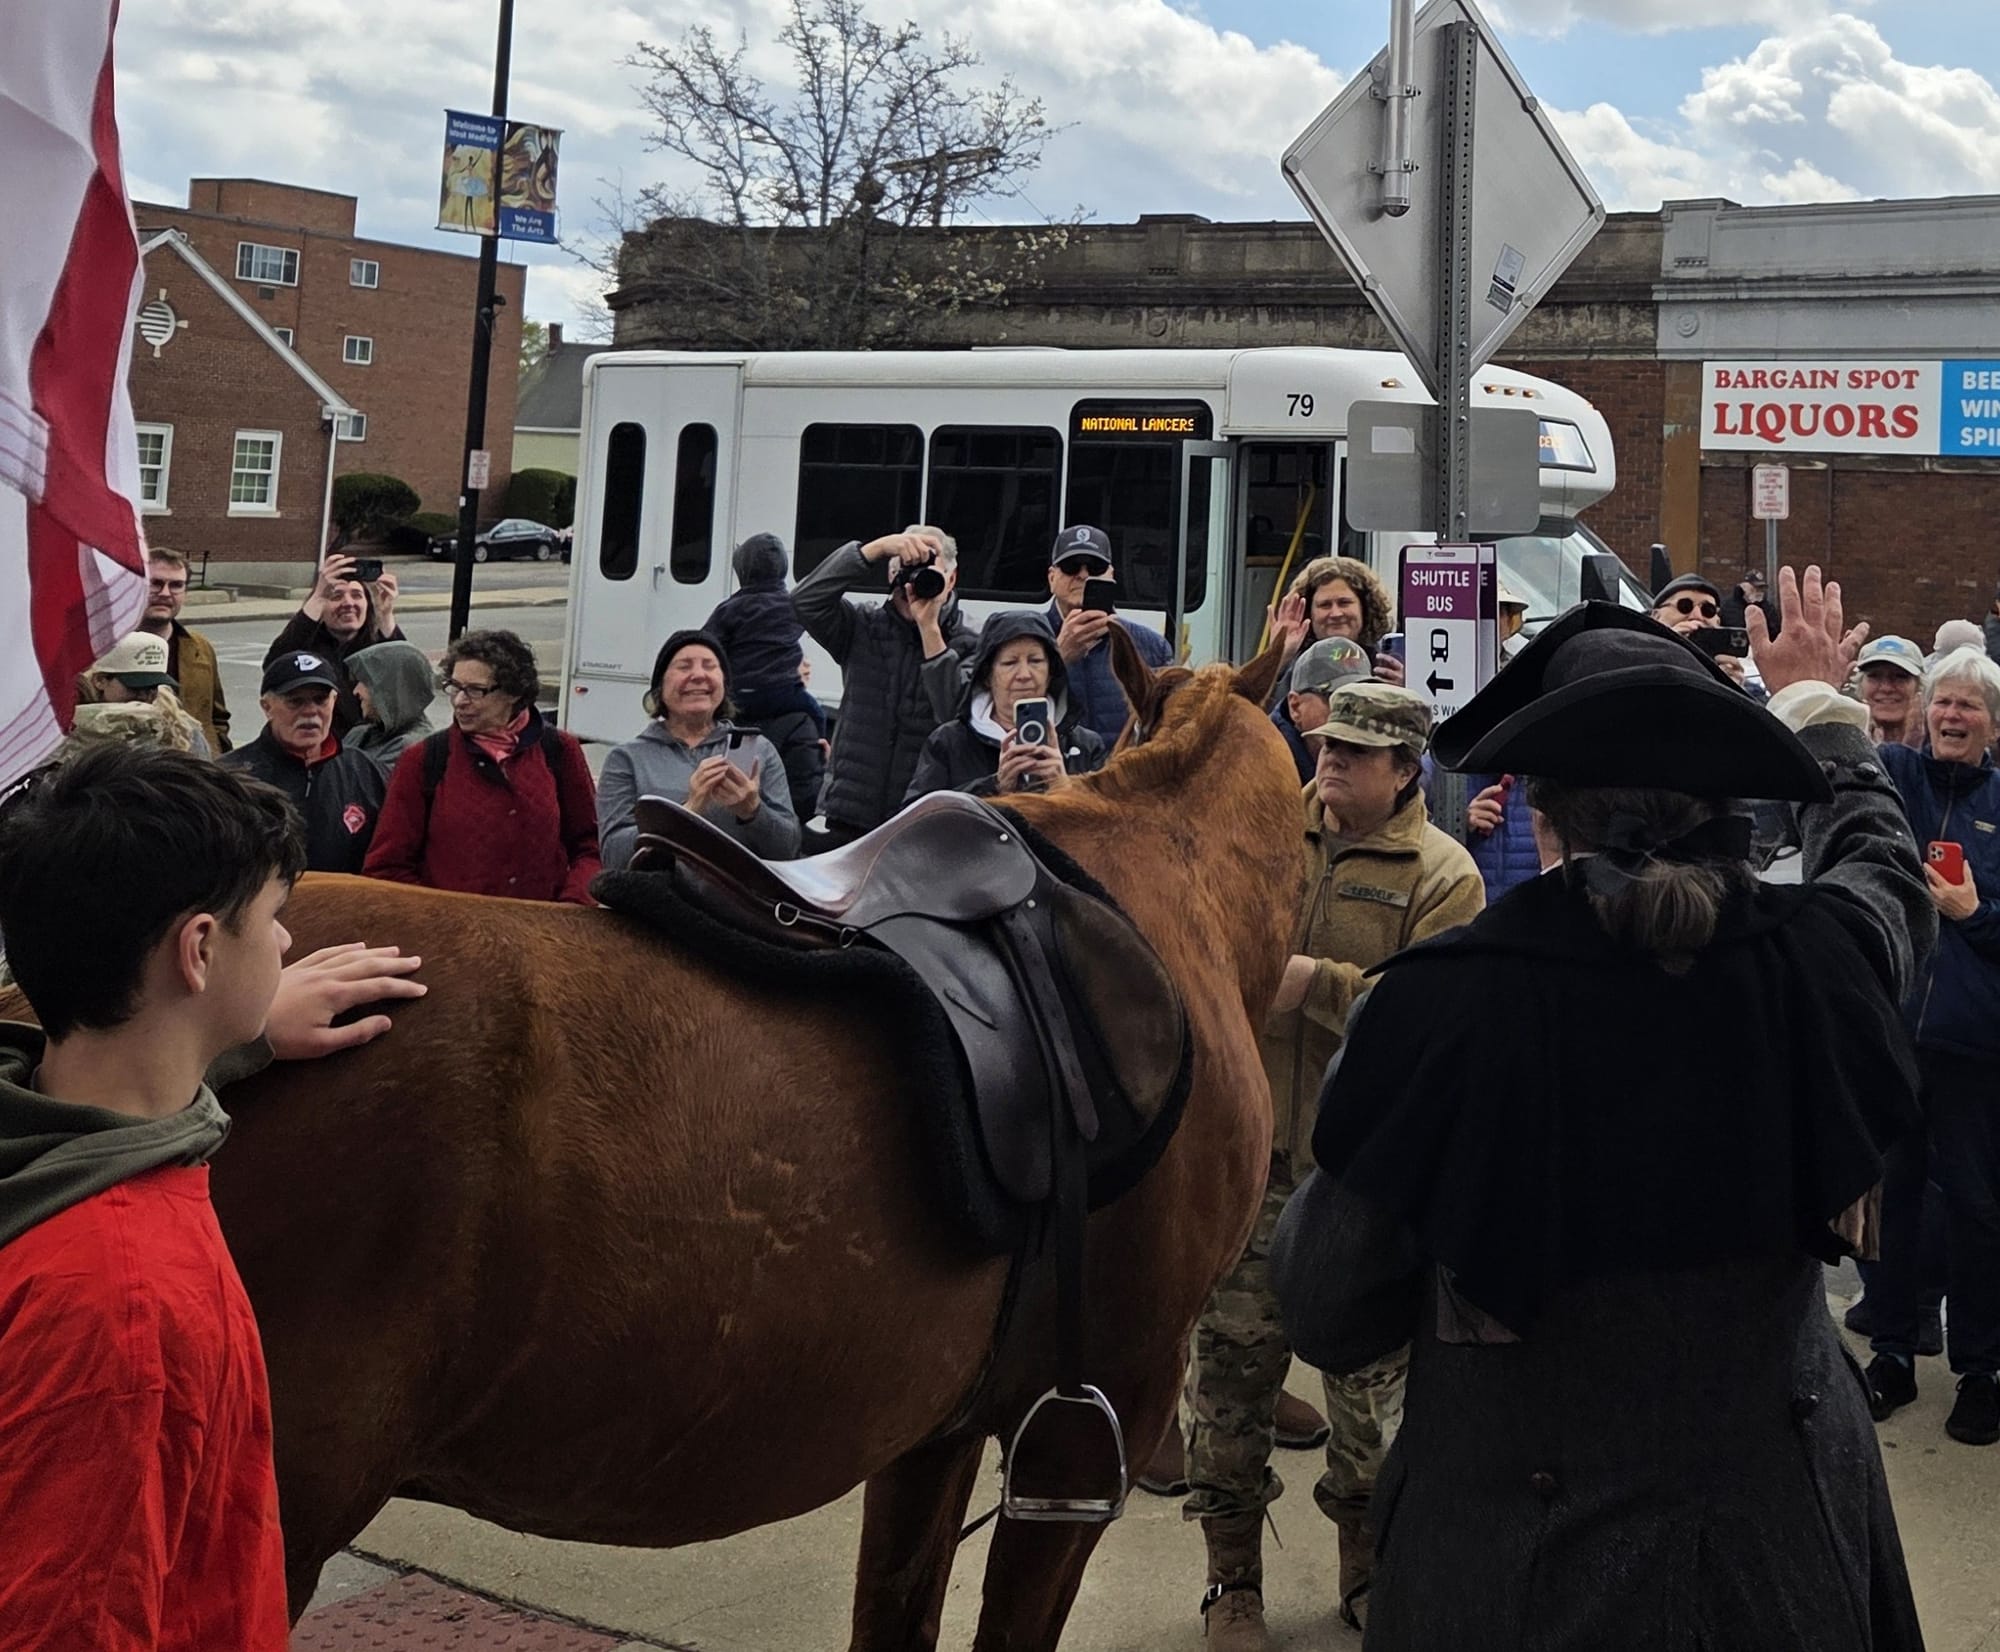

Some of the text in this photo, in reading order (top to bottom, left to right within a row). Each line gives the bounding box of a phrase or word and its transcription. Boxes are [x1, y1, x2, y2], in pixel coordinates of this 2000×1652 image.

[452, 119, 496, 134] Welcome to
[449, 129, 498, 144] West Medford
[515, 214, 542, 226] We Are
[512, 223, 544, 236] The Arts
[1714, 370, 1920, 389] BARGAIN SPOT
[1963, 371, 2000, 390] BEE
[1287, 394, 1314, 417] 79
[1961, 400, 2000, 418] WIN
[1082, 417, 1194, 431] NATIONAL LANCERS
[1713, 403, 1919, 443] LIQUORS
[1960, 427, 2000, 446] SPI
[1411, 570, 1470, 587] SHUTTLE
[1427, 596, 1453, 612] BUS
[1441, 704, 1459, 716] WA
